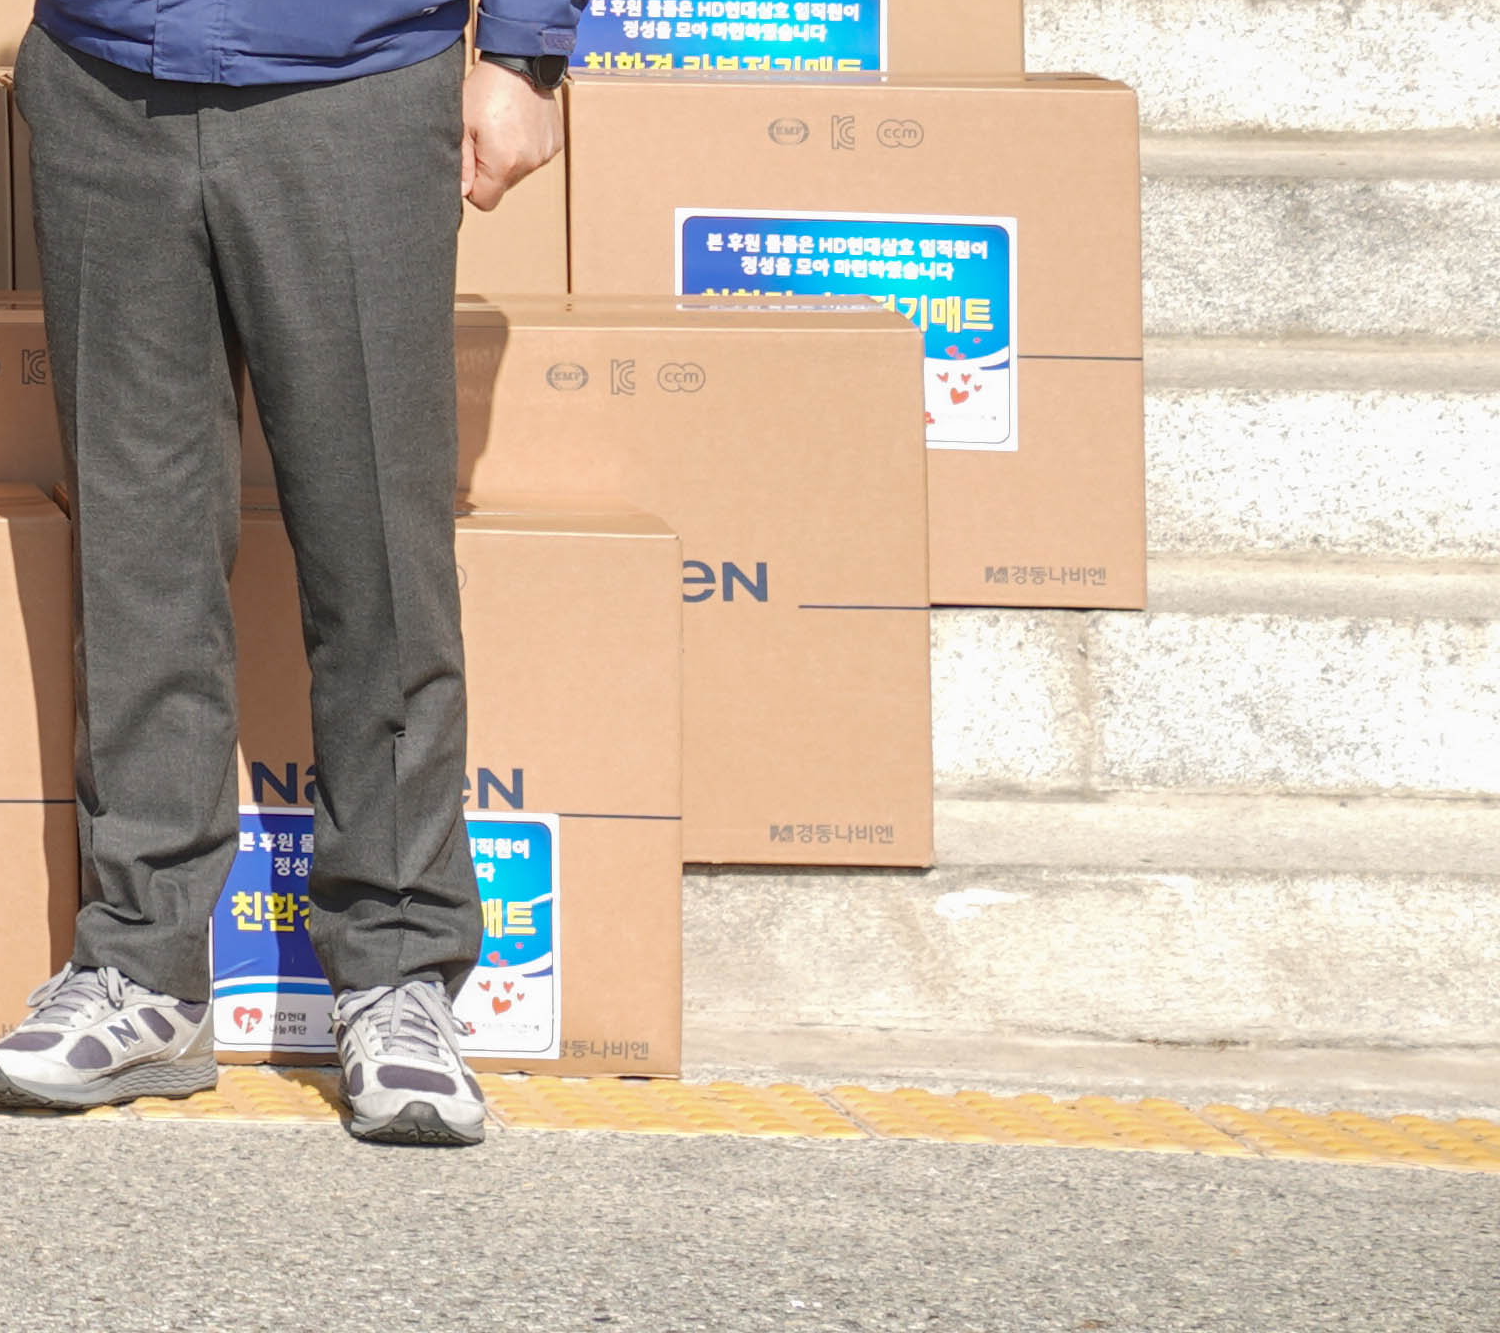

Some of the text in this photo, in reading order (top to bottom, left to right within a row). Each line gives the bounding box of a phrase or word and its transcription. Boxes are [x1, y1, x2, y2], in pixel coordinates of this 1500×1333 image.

[1011, 565, 1107, 586] 경동나비엔
[796, 824, 894, 844] 경동나비엔
[107, 1017, 142, 1051] N
